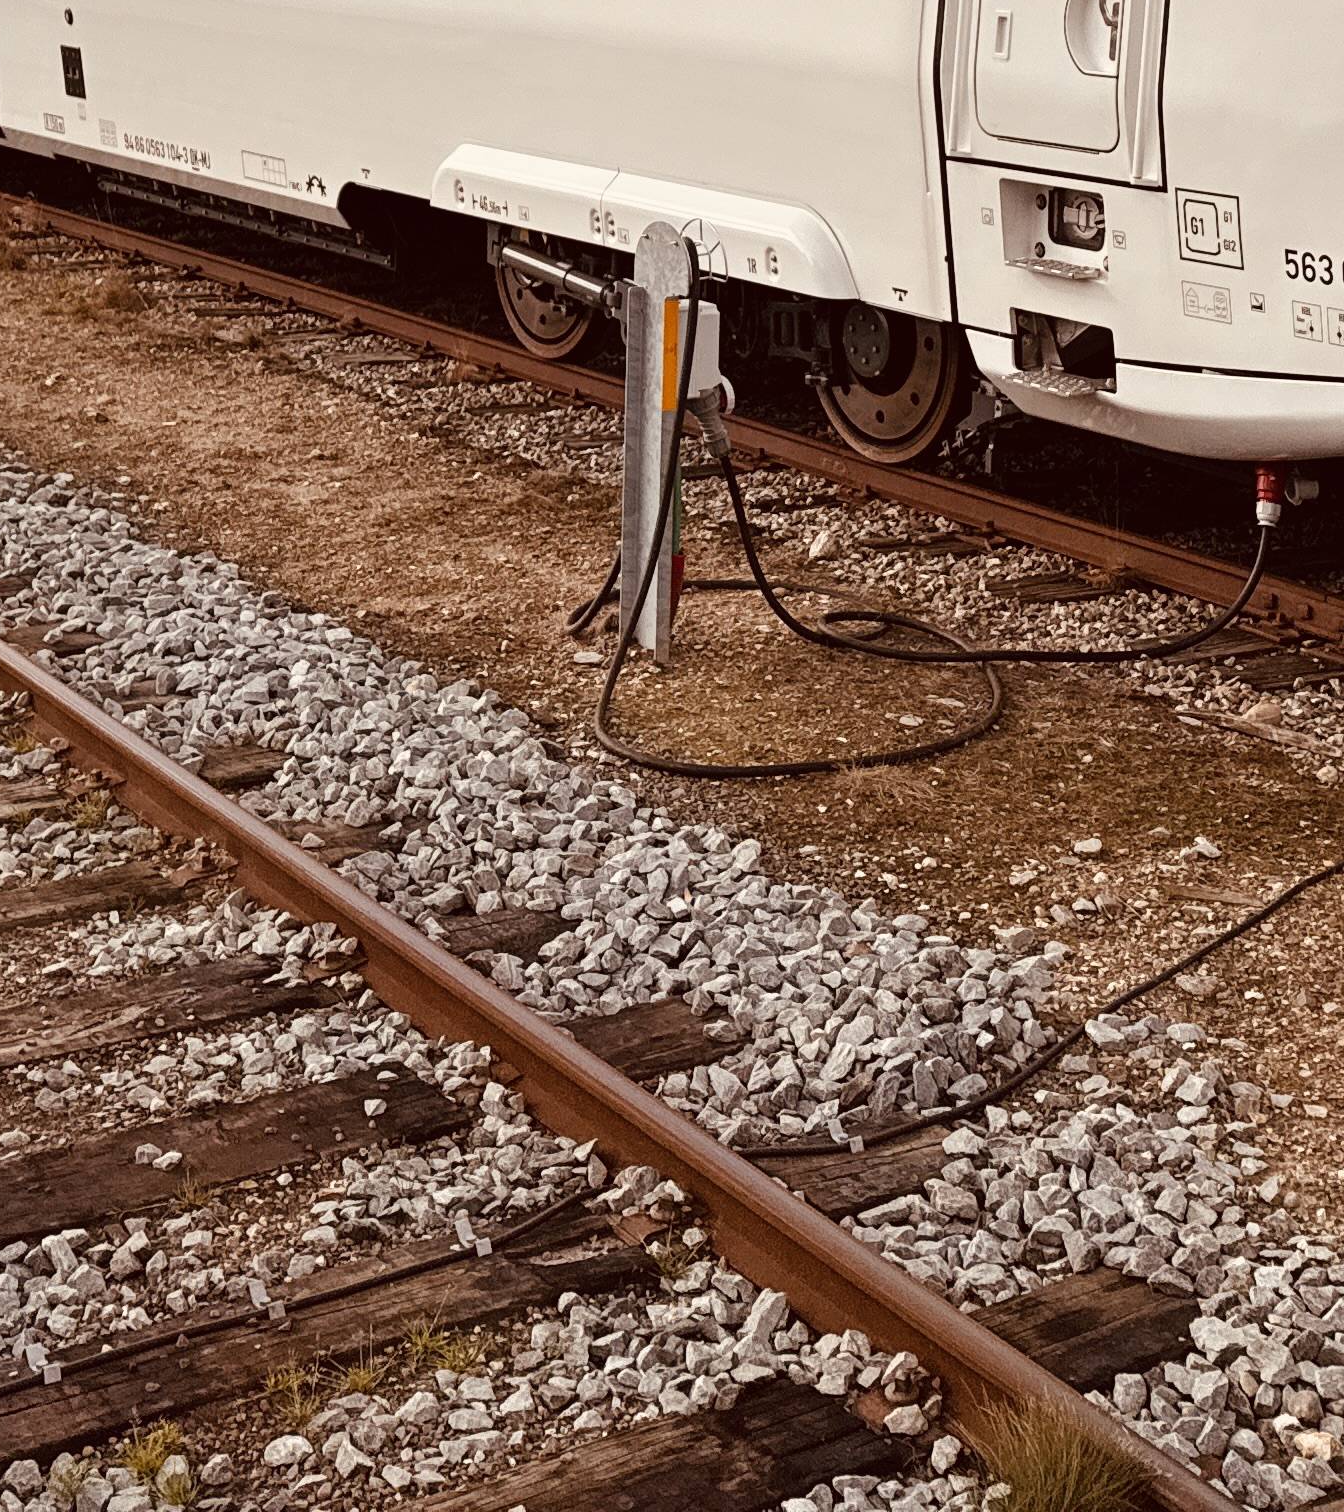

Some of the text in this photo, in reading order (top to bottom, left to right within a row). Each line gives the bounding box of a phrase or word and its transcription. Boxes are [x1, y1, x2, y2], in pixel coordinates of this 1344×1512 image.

[145, 137, 165, 158] 0563
[166, 142, 188, 164] 104-3
[1190, 216, 1205, 237] G1
[1284, 248, 1334, 286] 563
